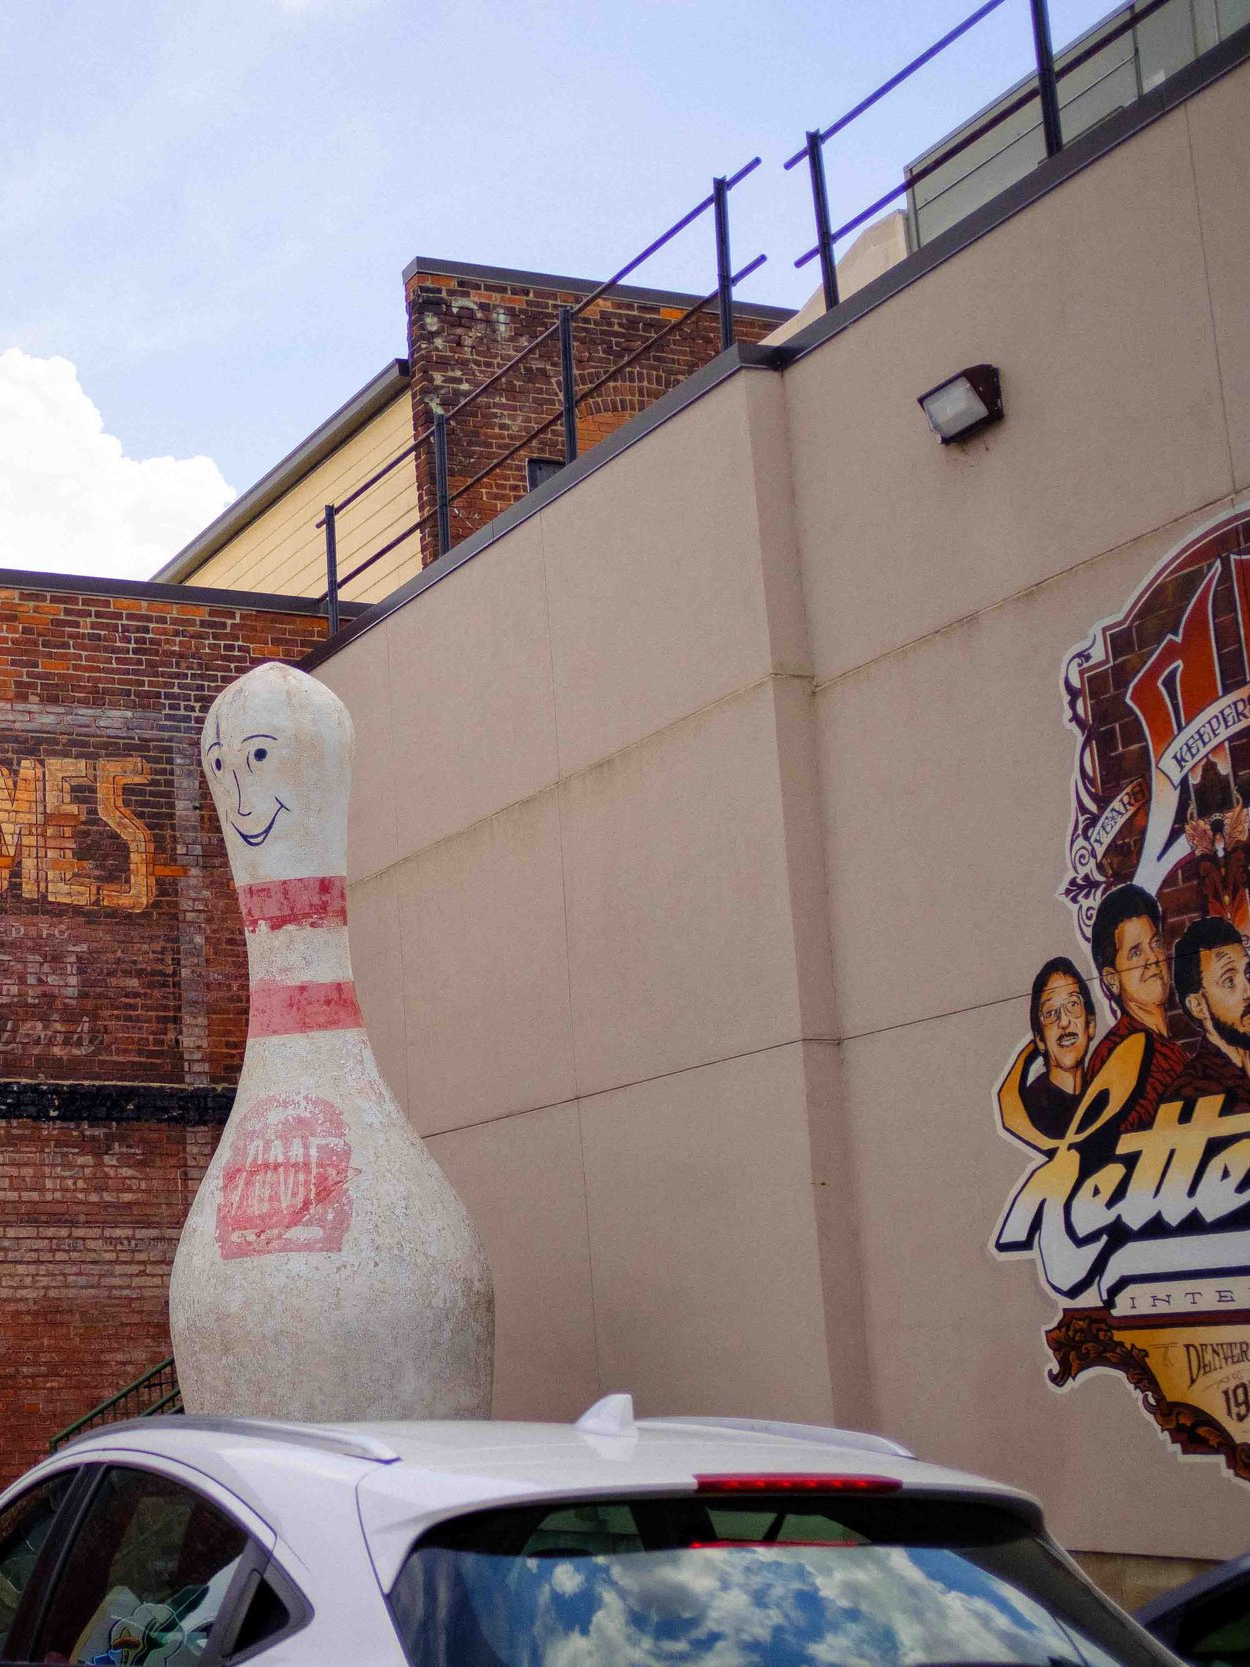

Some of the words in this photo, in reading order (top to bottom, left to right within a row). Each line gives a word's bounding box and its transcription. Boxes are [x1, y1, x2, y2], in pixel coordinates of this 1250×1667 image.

[1171, 693, 1250, 773] KEEPER
[1093, 781, 1146, 847] YEARS
[1129, 1287, 1250, 1309] INTE
[1222, 1380, 1250, 1423] 19
